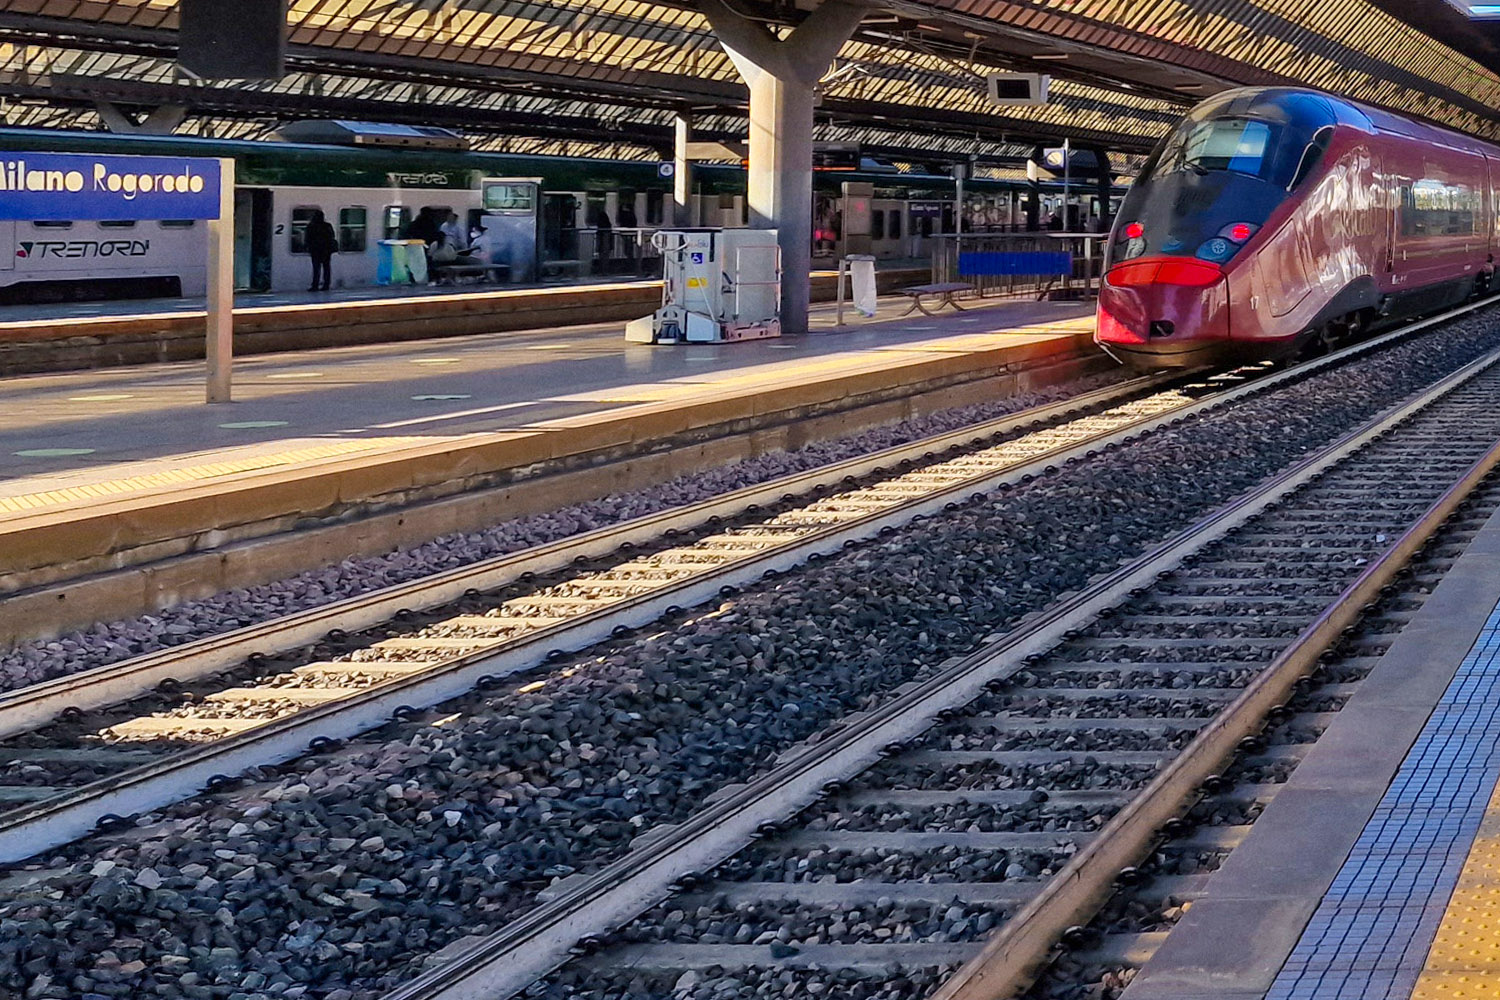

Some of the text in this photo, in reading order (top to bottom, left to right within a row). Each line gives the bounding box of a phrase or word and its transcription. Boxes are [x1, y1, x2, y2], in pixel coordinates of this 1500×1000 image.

[93, 163, 204, 200] Rogoredo
[575, 201, 583, 211] 2
[275, 224, 284, 235] 2
[36, 240, 150, 258] TRENORD
